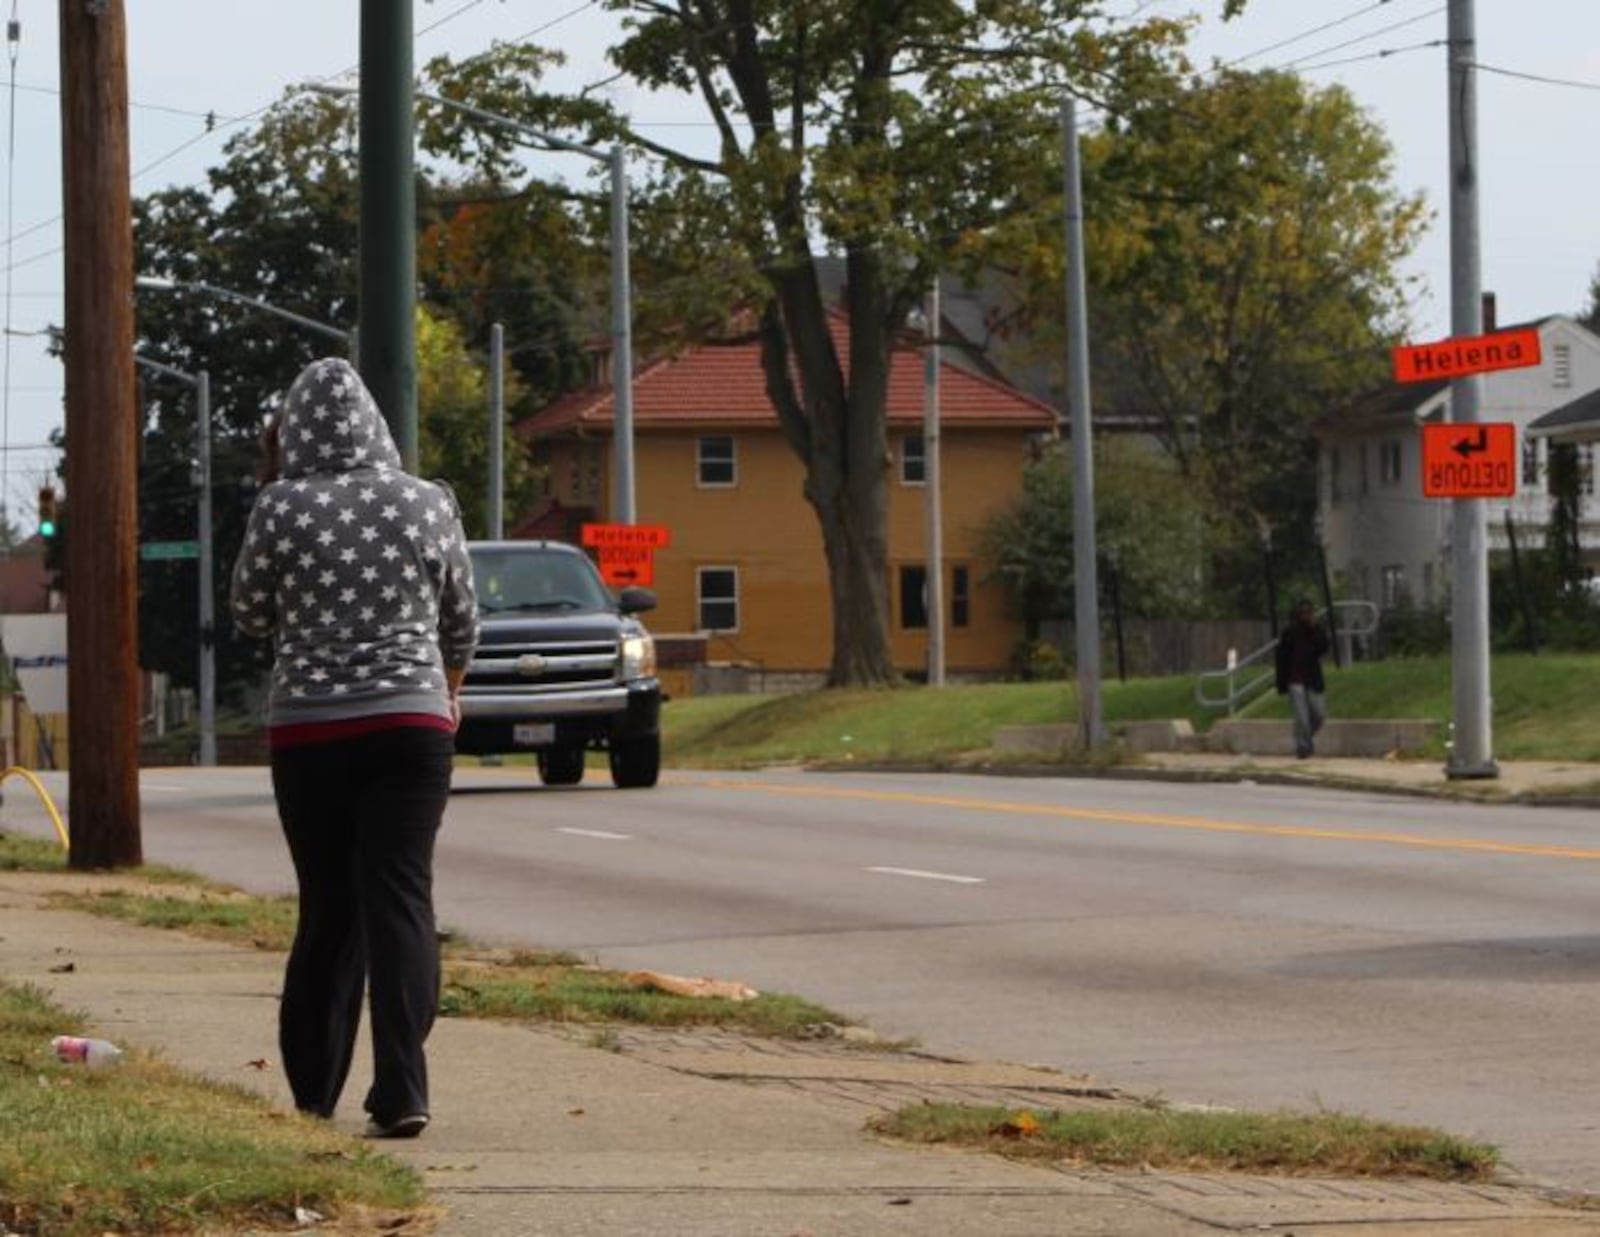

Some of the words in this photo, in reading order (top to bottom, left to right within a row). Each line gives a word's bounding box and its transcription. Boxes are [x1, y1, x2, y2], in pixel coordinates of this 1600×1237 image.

[1413, 341, 1522, 373] Helena
[1431, 461, 1508, 489] DETOUR
[593, 528, 658, 544] Helena
